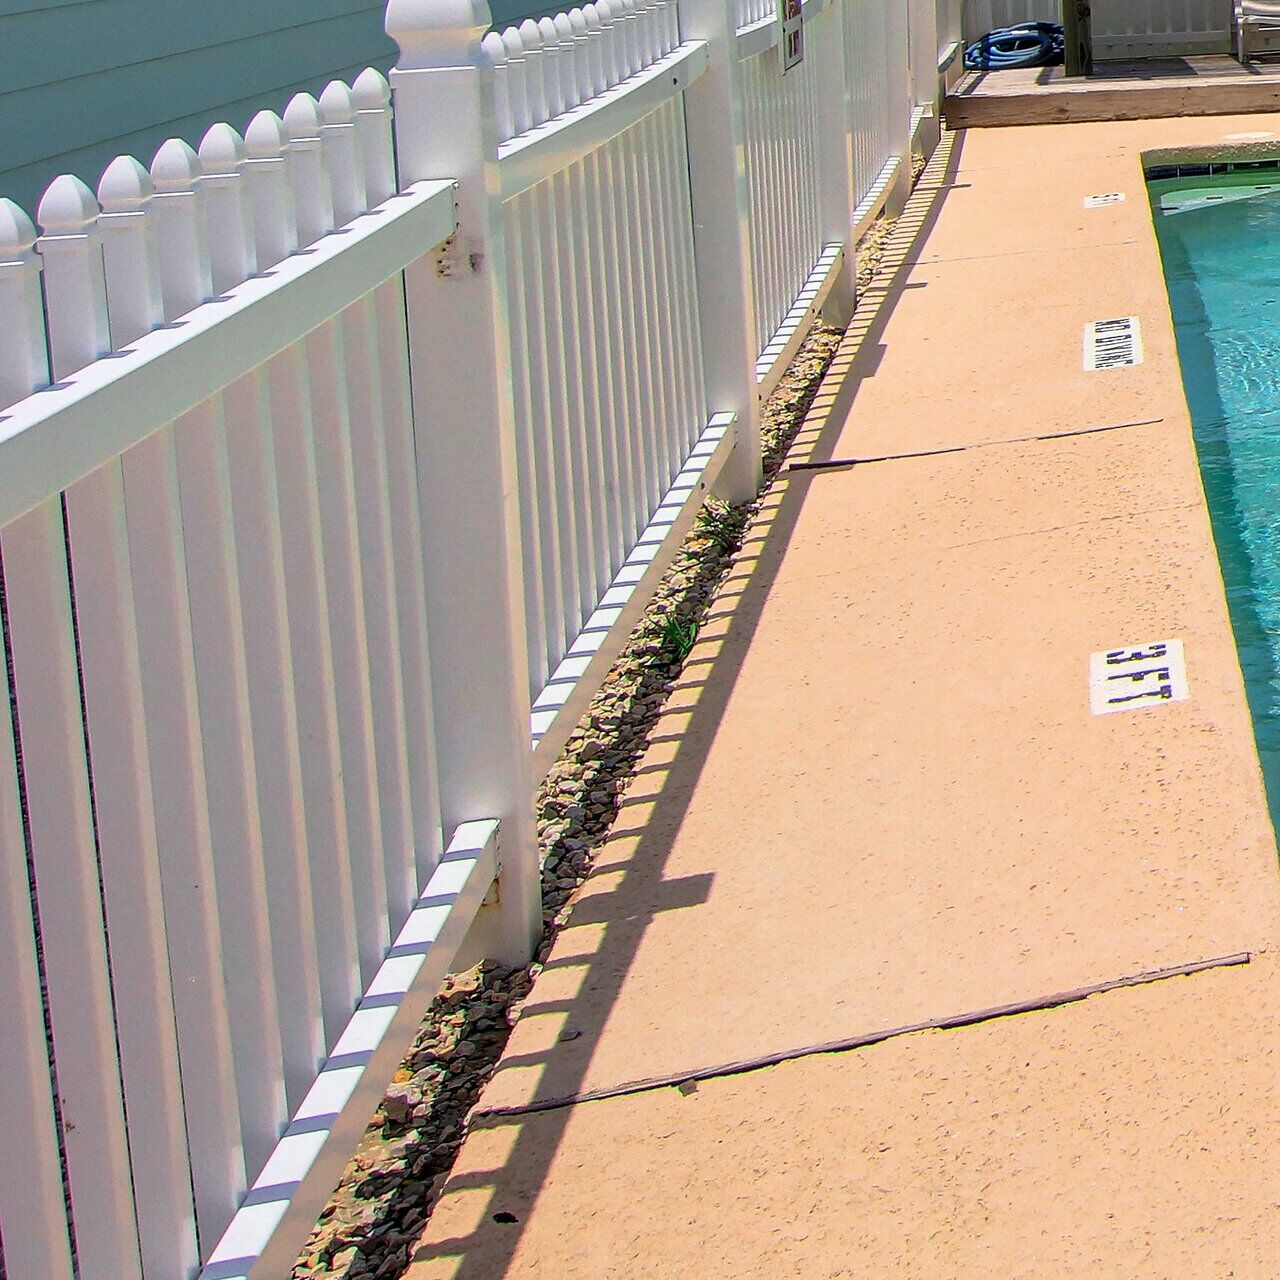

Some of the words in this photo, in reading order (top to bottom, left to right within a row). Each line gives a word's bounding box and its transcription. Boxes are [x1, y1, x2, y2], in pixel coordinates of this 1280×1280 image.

[1095, 334, 1134, 369] DIVING
[1106, 643, 1167, 665] 3
[1107, 667, 1173, 704] FT
